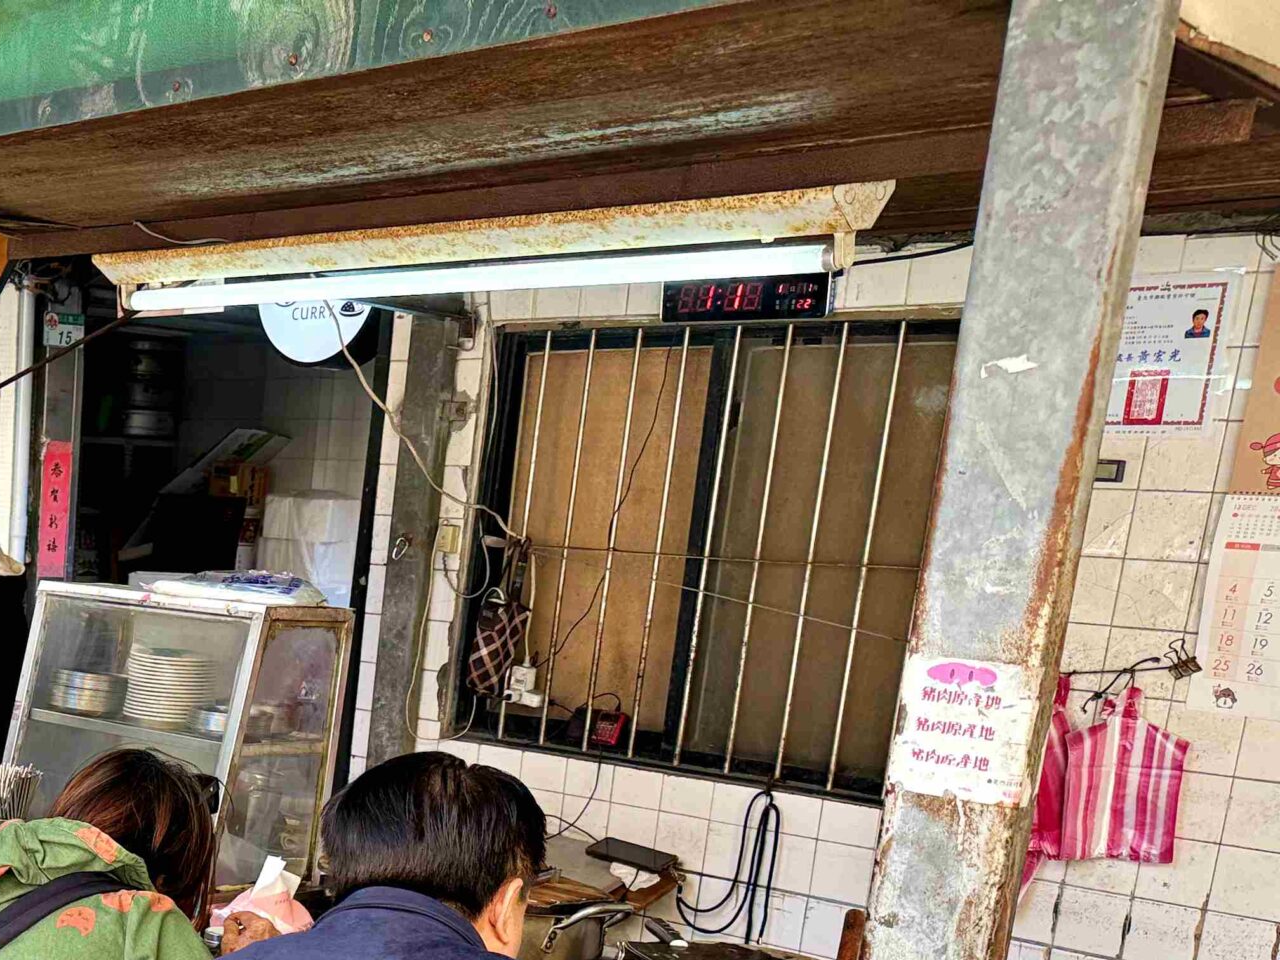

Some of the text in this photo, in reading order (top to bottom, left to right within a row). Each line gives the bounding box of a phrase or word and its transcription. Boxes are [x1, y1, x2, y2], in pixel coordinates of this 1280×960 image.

[1228, 583, 1275, 598] 4 5
[1223, 608, 1273, 625] 11 12
[1219, 633, 1269, 650] 18 19
[1212, 658, 1264, 676] 25 26
